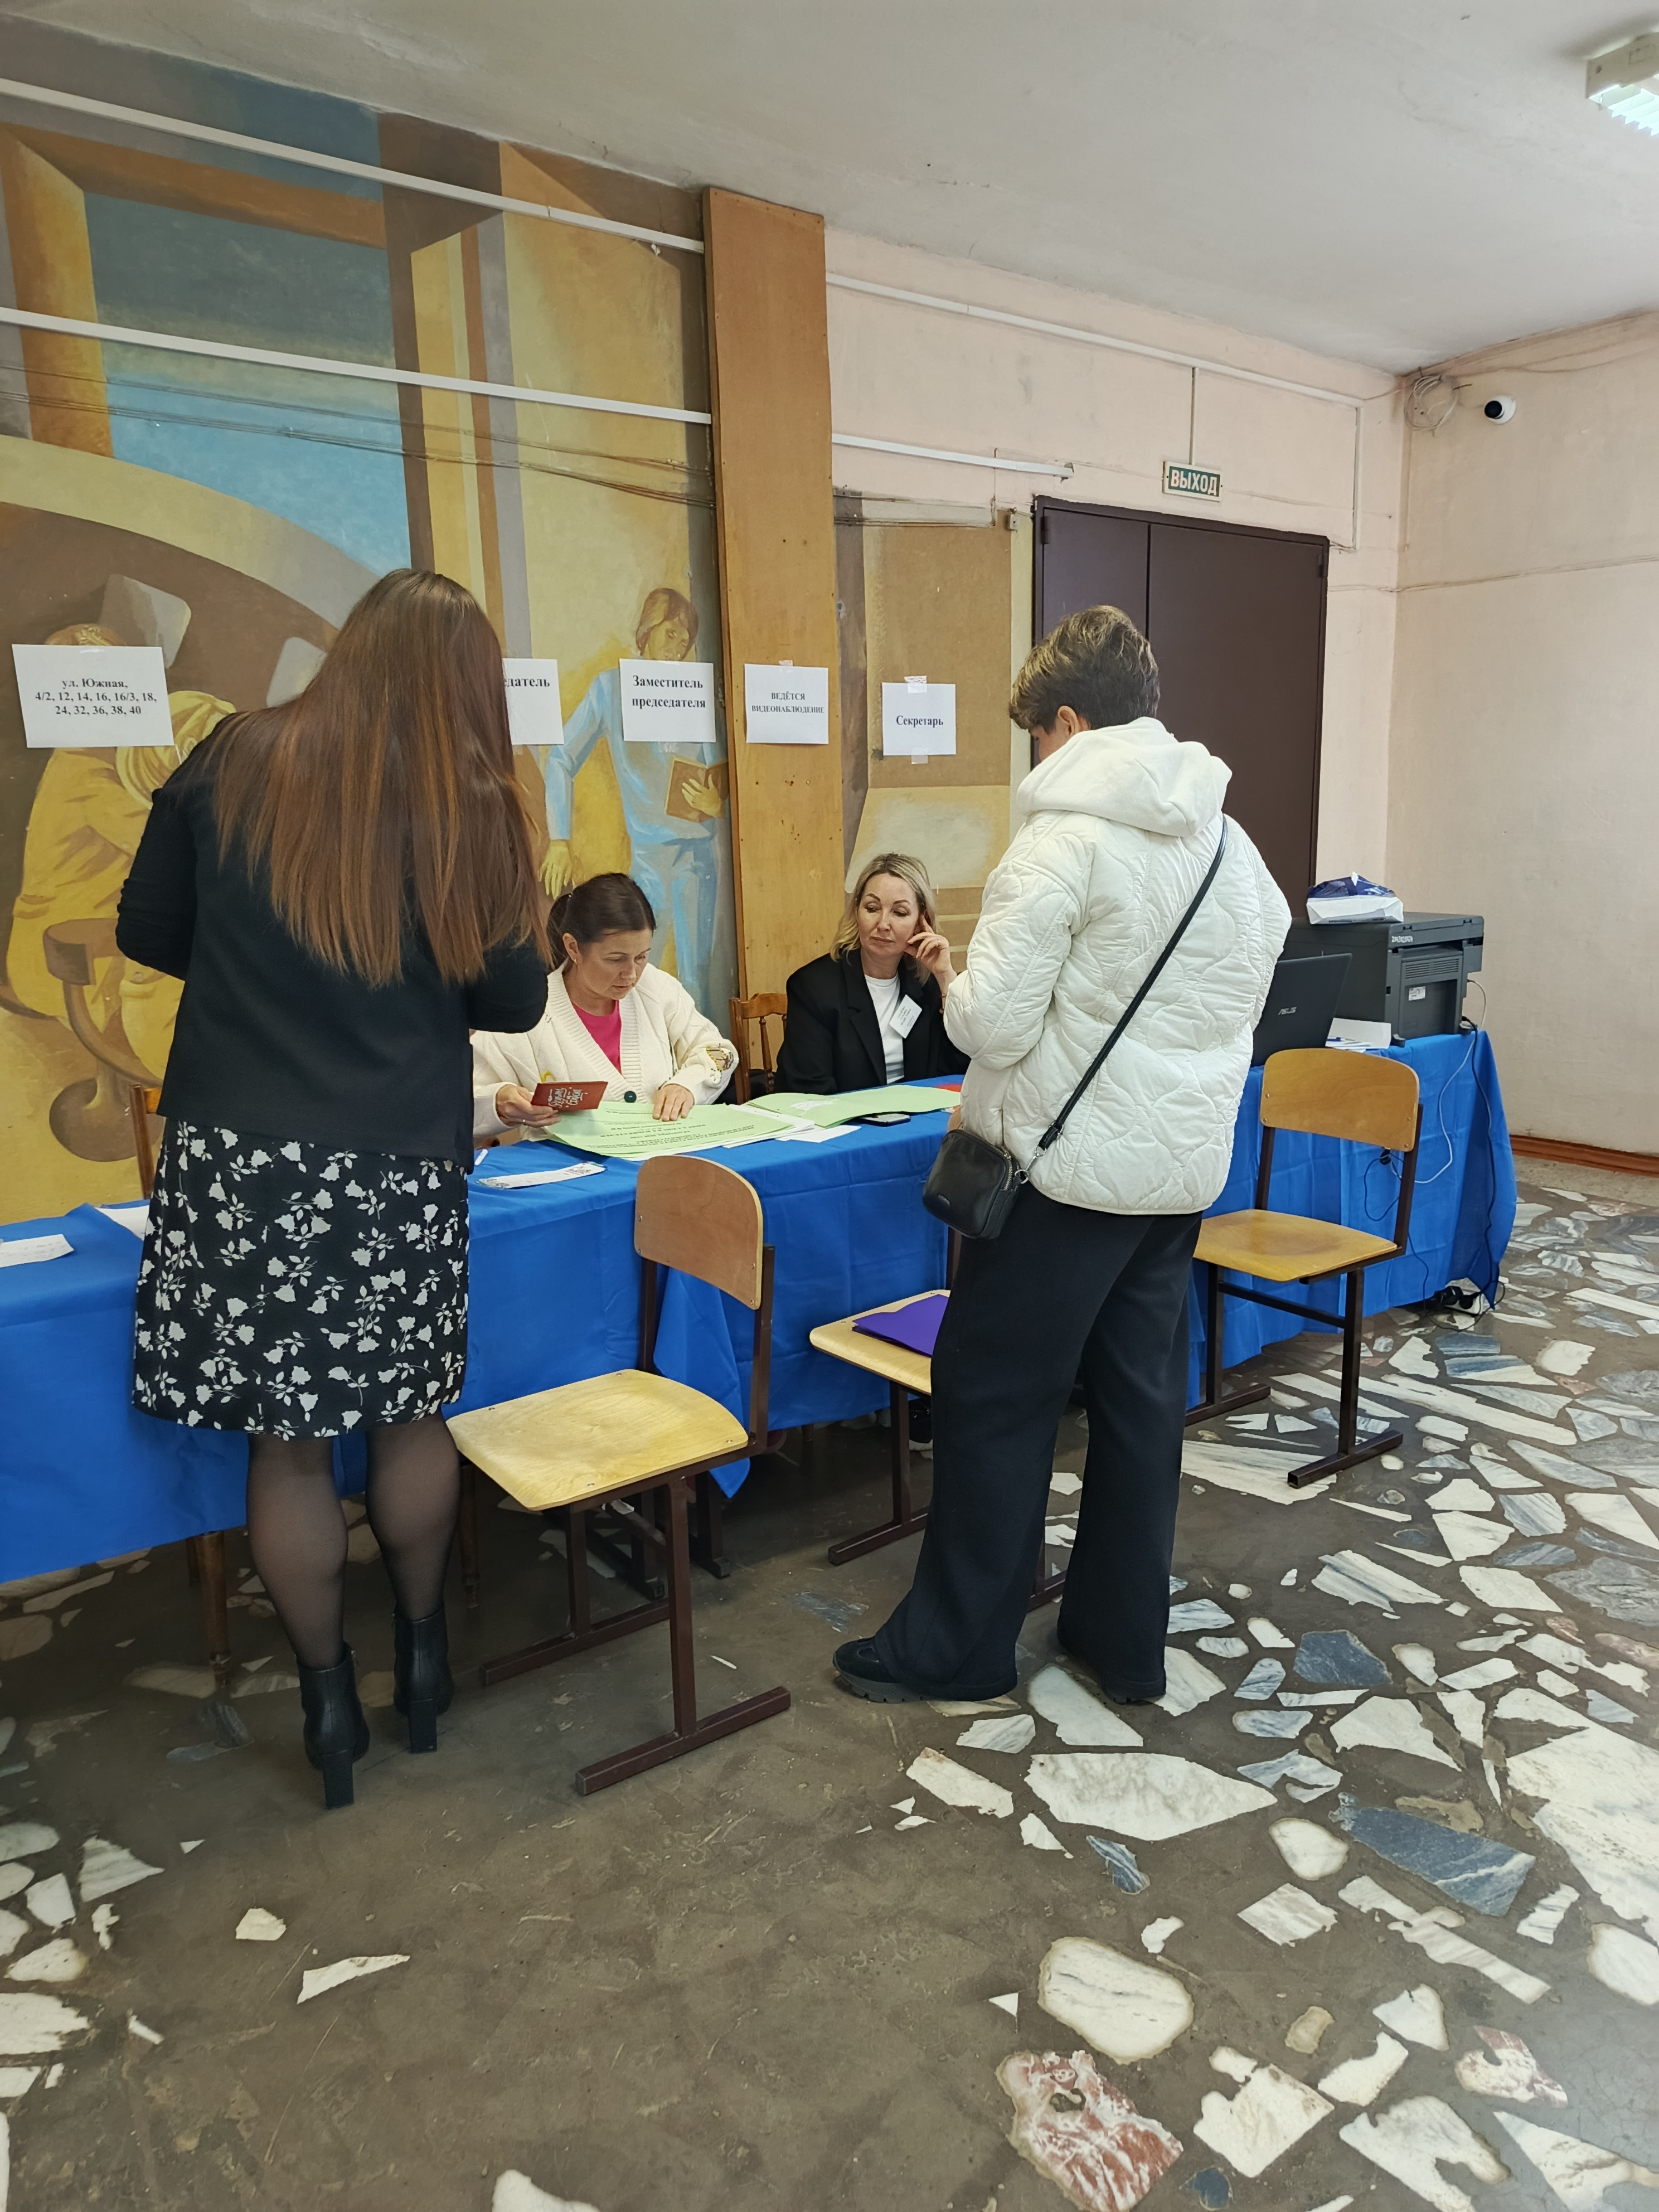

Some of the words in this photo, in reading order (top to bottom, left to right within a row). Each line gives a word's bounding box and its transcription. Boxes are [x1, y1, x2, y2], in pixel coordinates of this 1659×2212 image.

[1171, 469, 1217, 495] ВЫХОД
[62, 680, 79, 690] ул.
[81, 678, 128, 688] Южная,
[633, 675, 704, 688] Заместитель
[35, 691, 55, 702] 4/2,
[59, 692, 74, 702] 12,
[77, 692, 93, 702] 14,
[96, 692, 111, 702] 16,
[114, 692, 139, 702] 16/3,
[142, 692, 157, 702] 18,
[771, 691, 806, 701] ВЕДЁТСЯ
[632, 697, 706, 710] председателя
[55, 705, 71, 716] 24,
[74, 705, 90, 716] 32,
[93, 706, 108, 716] 36,
[111, 706, 127, 716] 38,
[129, 706, 142, 715] 40
[751, 705, 824, 714] ВИДЕОНАБЛЮДЕНИЕ
[896, 715, 944, 728] Секретарь
[1278, 1007, 1297, 1015] ASUS
